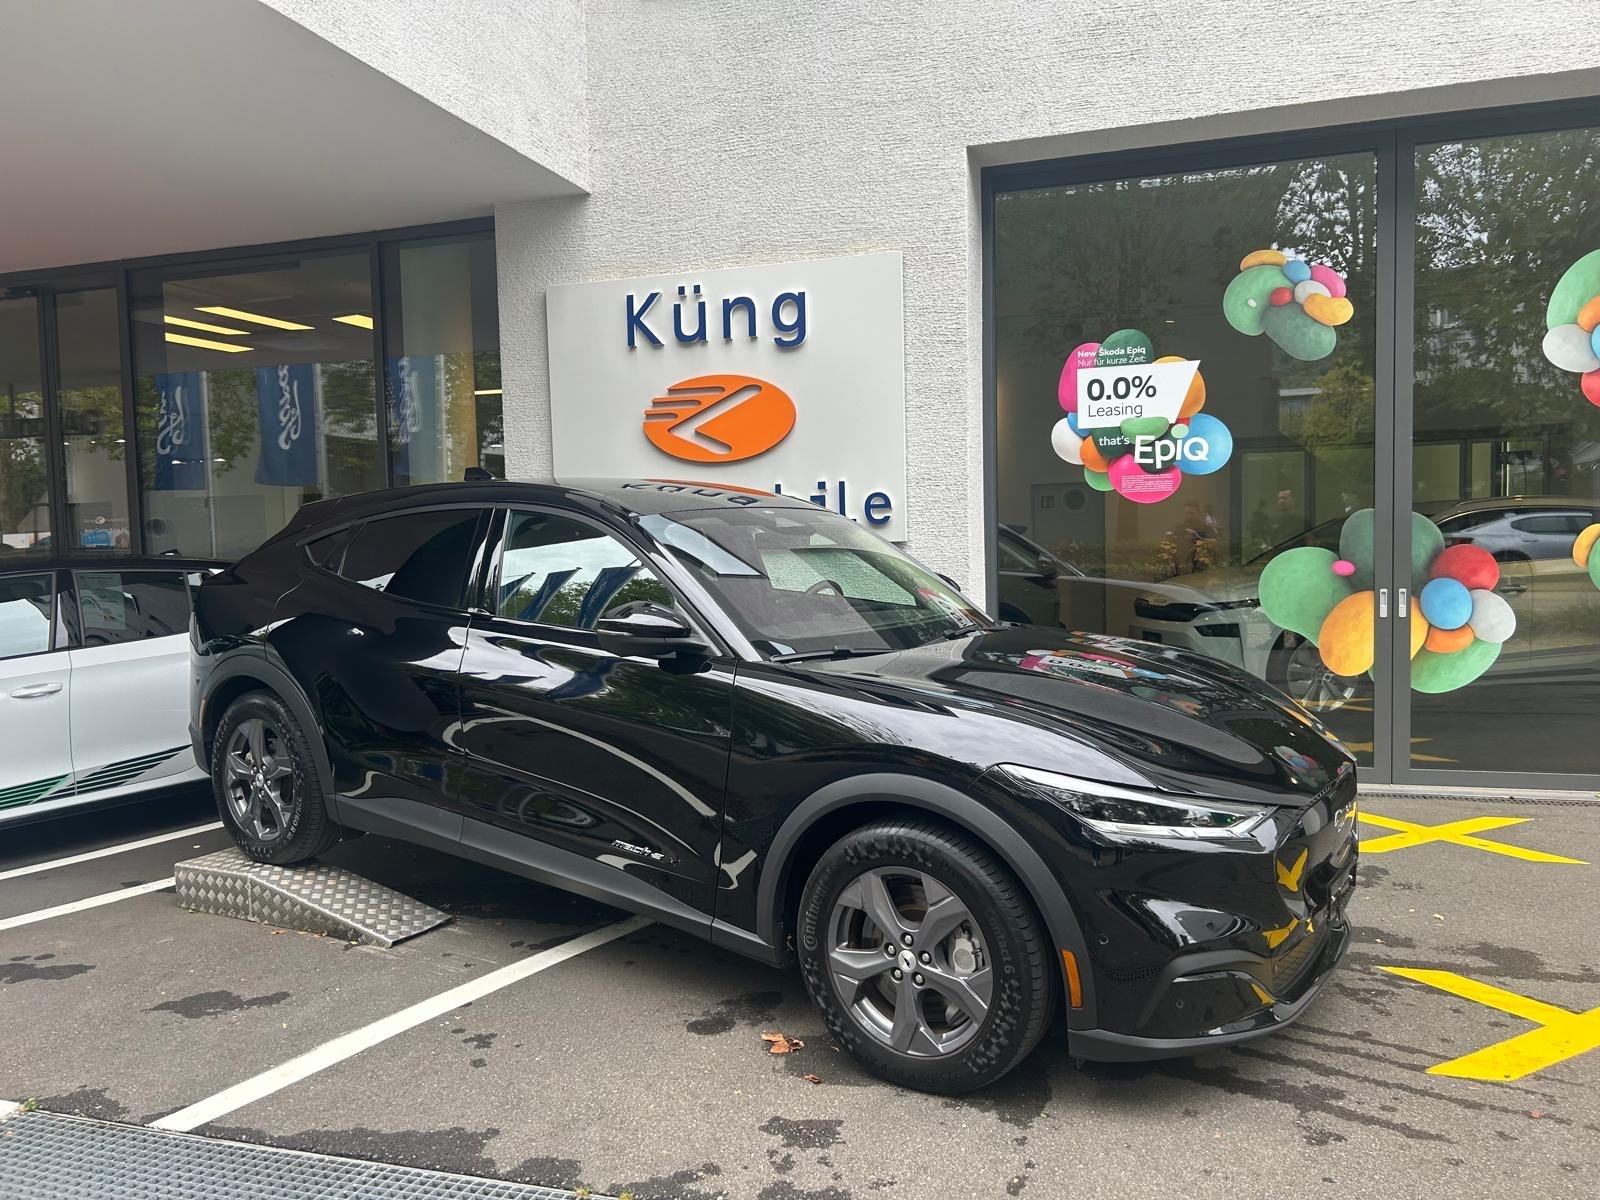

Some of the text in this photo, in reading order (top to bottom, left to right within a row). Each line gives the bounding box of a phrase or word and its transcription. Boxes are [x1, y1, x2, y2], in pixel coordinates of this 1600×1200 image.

[625, 284, 808, 349] Küng
[1077, 346, 1146, 358] New Škoda Epiq
[1077, 359, 1092, 367] Nur
[1093, 358, 1104, 367] für
[1106, 357, 1128, 366] kurze
[1086, 374, 1157, 402] 0.0%
[1087, 403, 1143, 418] Leasing
[1098, 434, 1130, 447] that's
